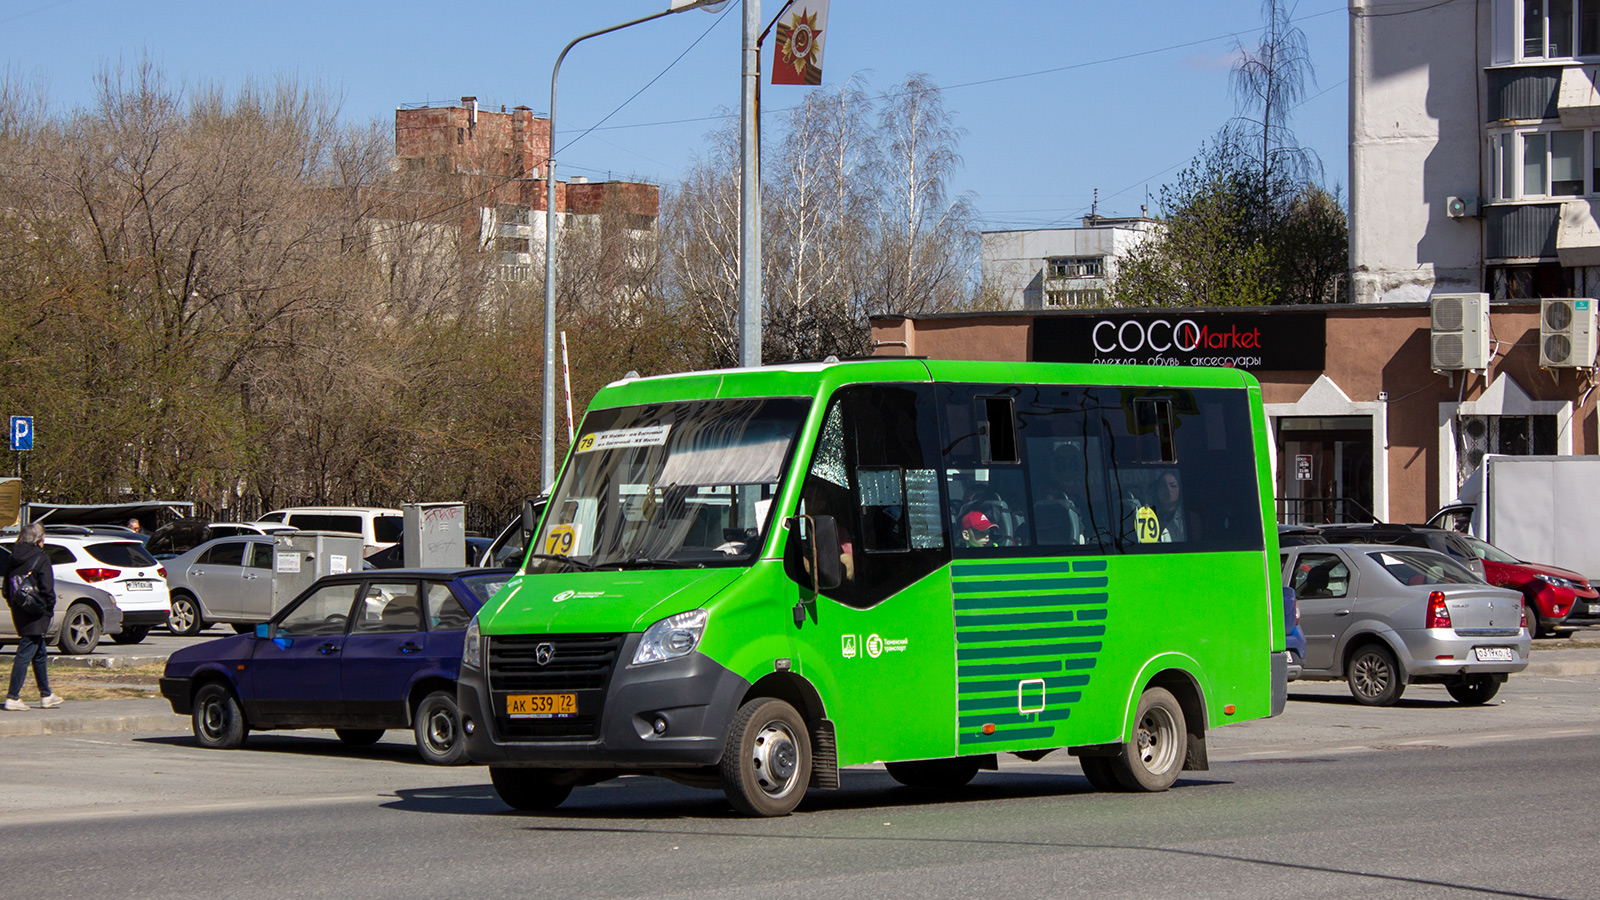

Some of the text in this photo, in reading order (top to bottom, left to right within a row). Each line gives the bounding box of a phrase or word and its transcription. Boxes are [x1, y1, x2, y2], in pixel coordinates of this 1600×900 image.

[1092, 319, 1262, 353] COCO Market
[1190, 356, 1262, 369] аксессуары
[15, 419, 29, 447] P
[580, 437, 594, 449] 79
[1138, 517, 1158, 539] 79
[550, 531, 573, 554] 79
[531, 697, 553, 711] 539
[560, 695, 573, 707] 72
